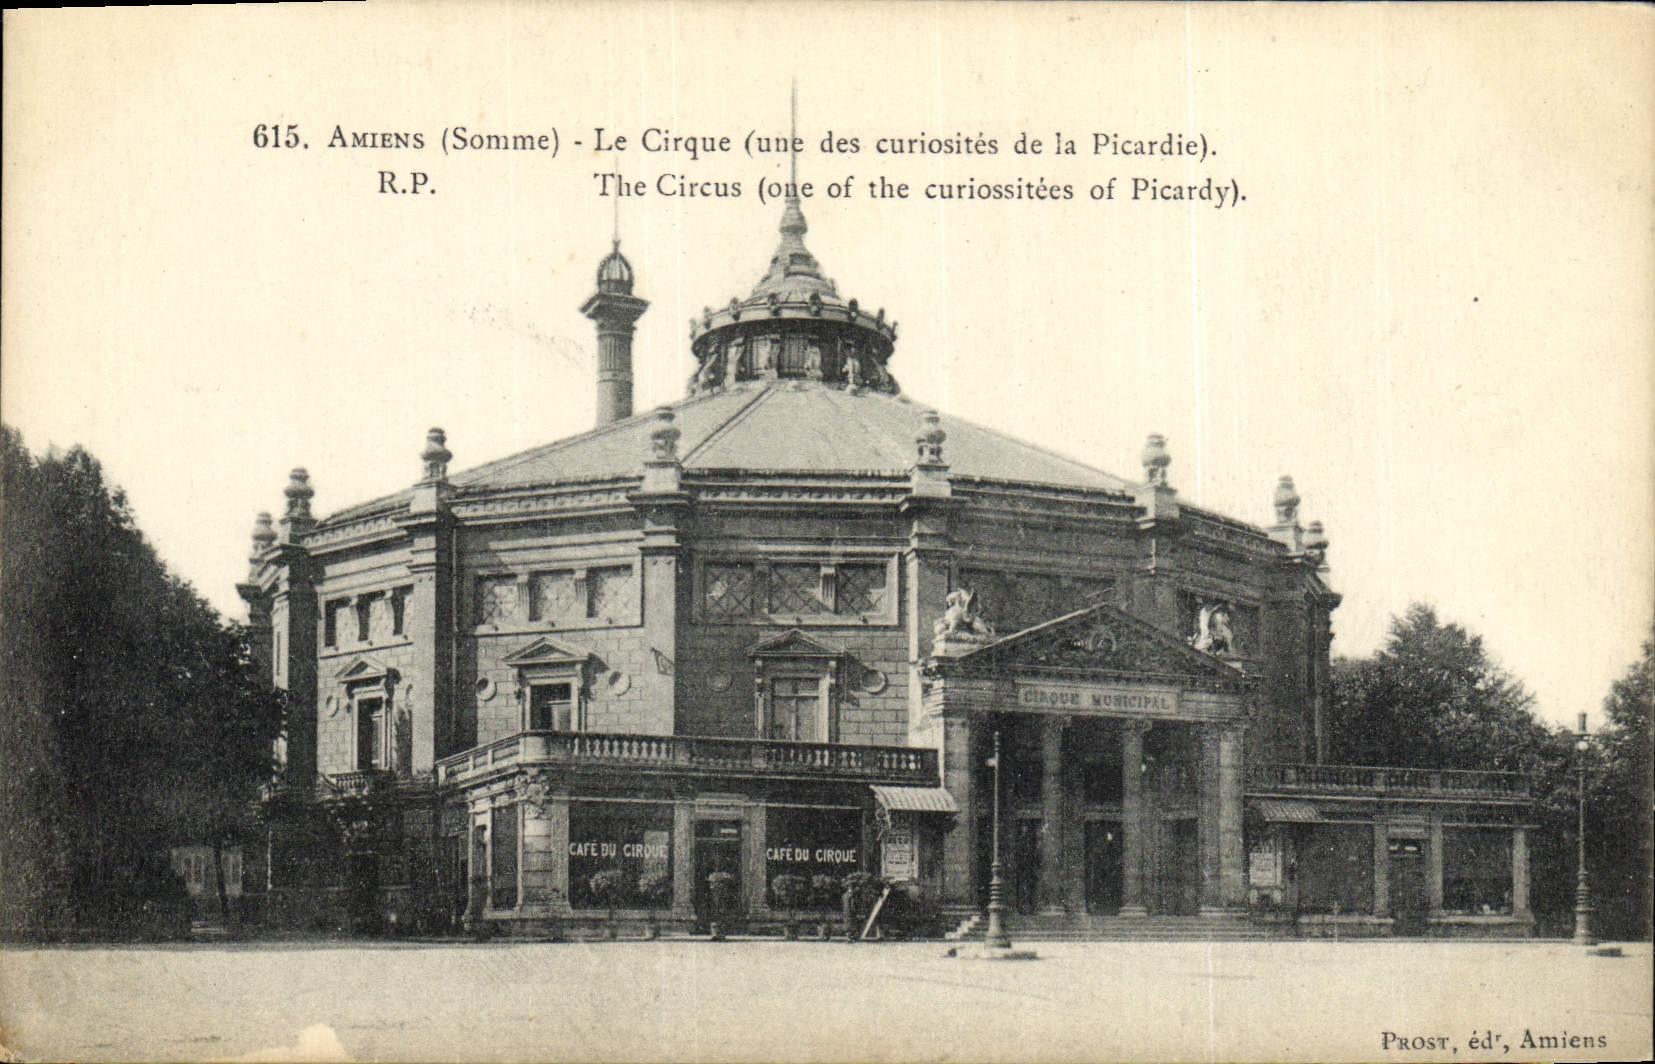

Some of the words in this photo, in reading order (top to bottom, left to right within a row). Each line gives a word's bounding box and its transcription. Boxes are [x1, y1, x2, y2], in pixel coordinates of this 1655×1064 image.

[1024, 689, 1081, 706] CIRQUE
[1091, 693, 1171, 711] MUNICIPAL
[601, 842, 616, 857] DU
[622, 843, 669, 859] CIRQUE
[794, 847, 810, 861] DU
[815, 848, 857, 863] CIRQUE
